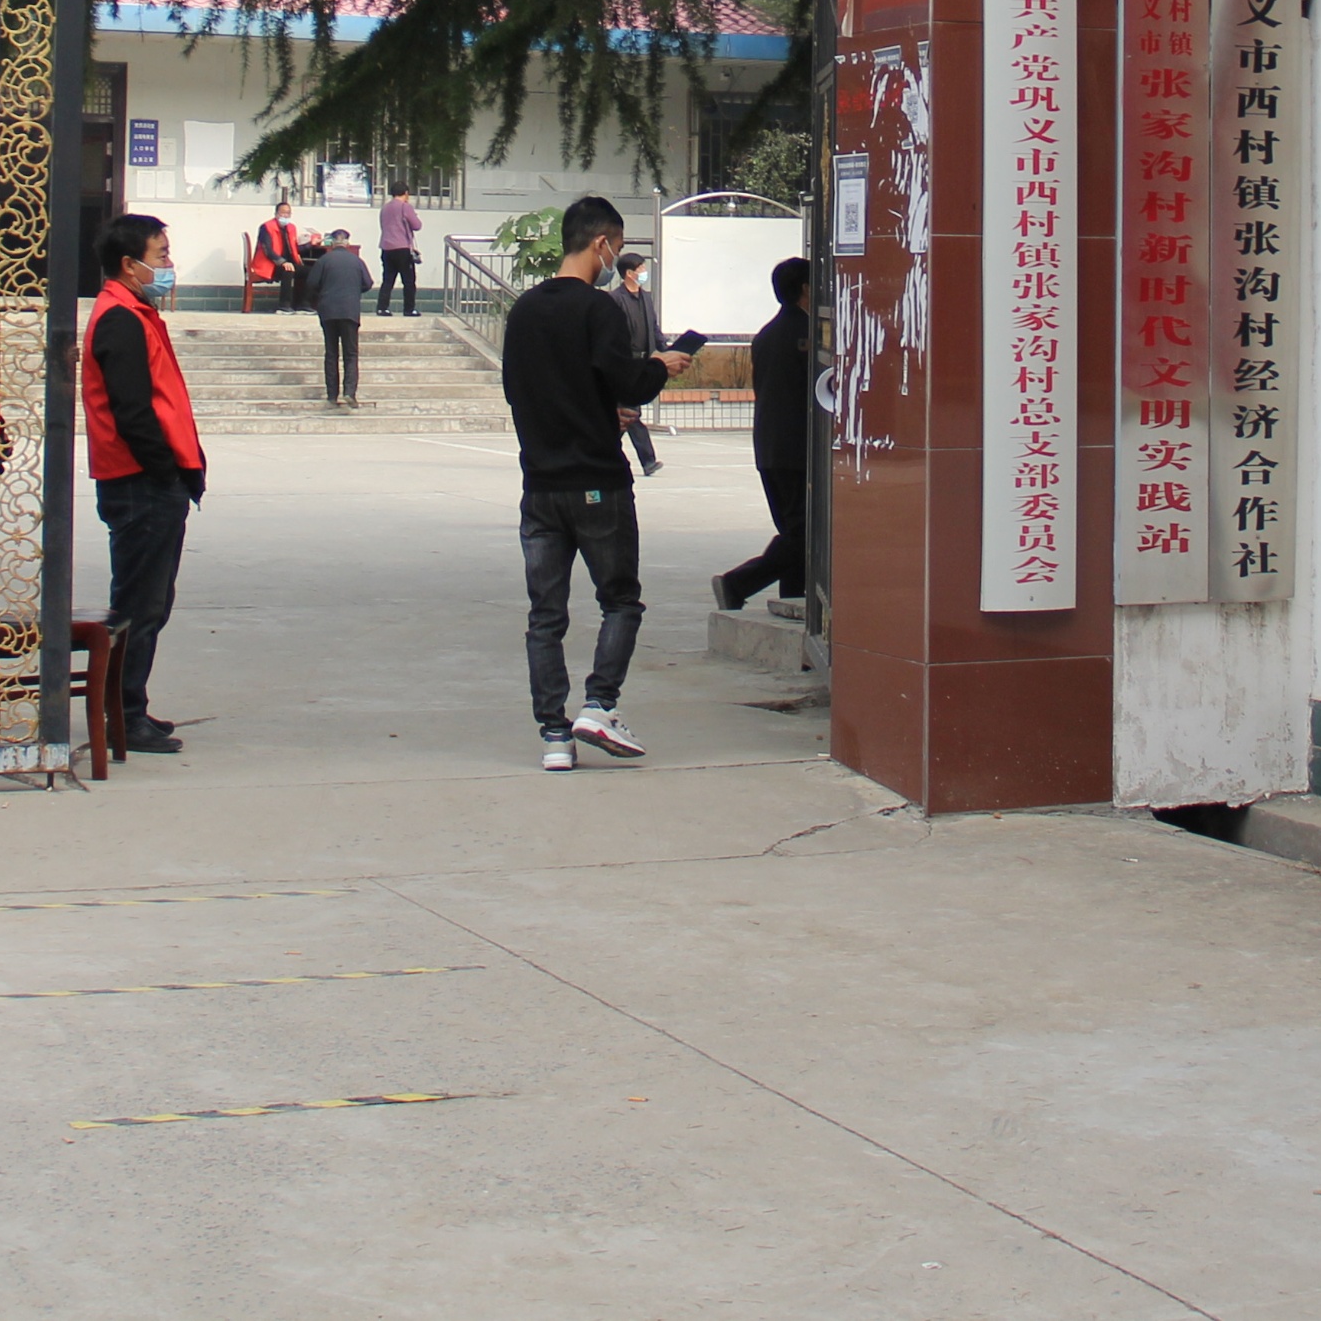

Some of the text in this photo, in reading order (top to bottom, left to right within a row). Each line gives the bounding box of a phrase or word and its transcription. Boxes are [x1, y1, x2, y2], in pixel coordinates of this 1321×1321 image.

[1136, 68, 1193, 554] 张家沟村新时代文明实践站
